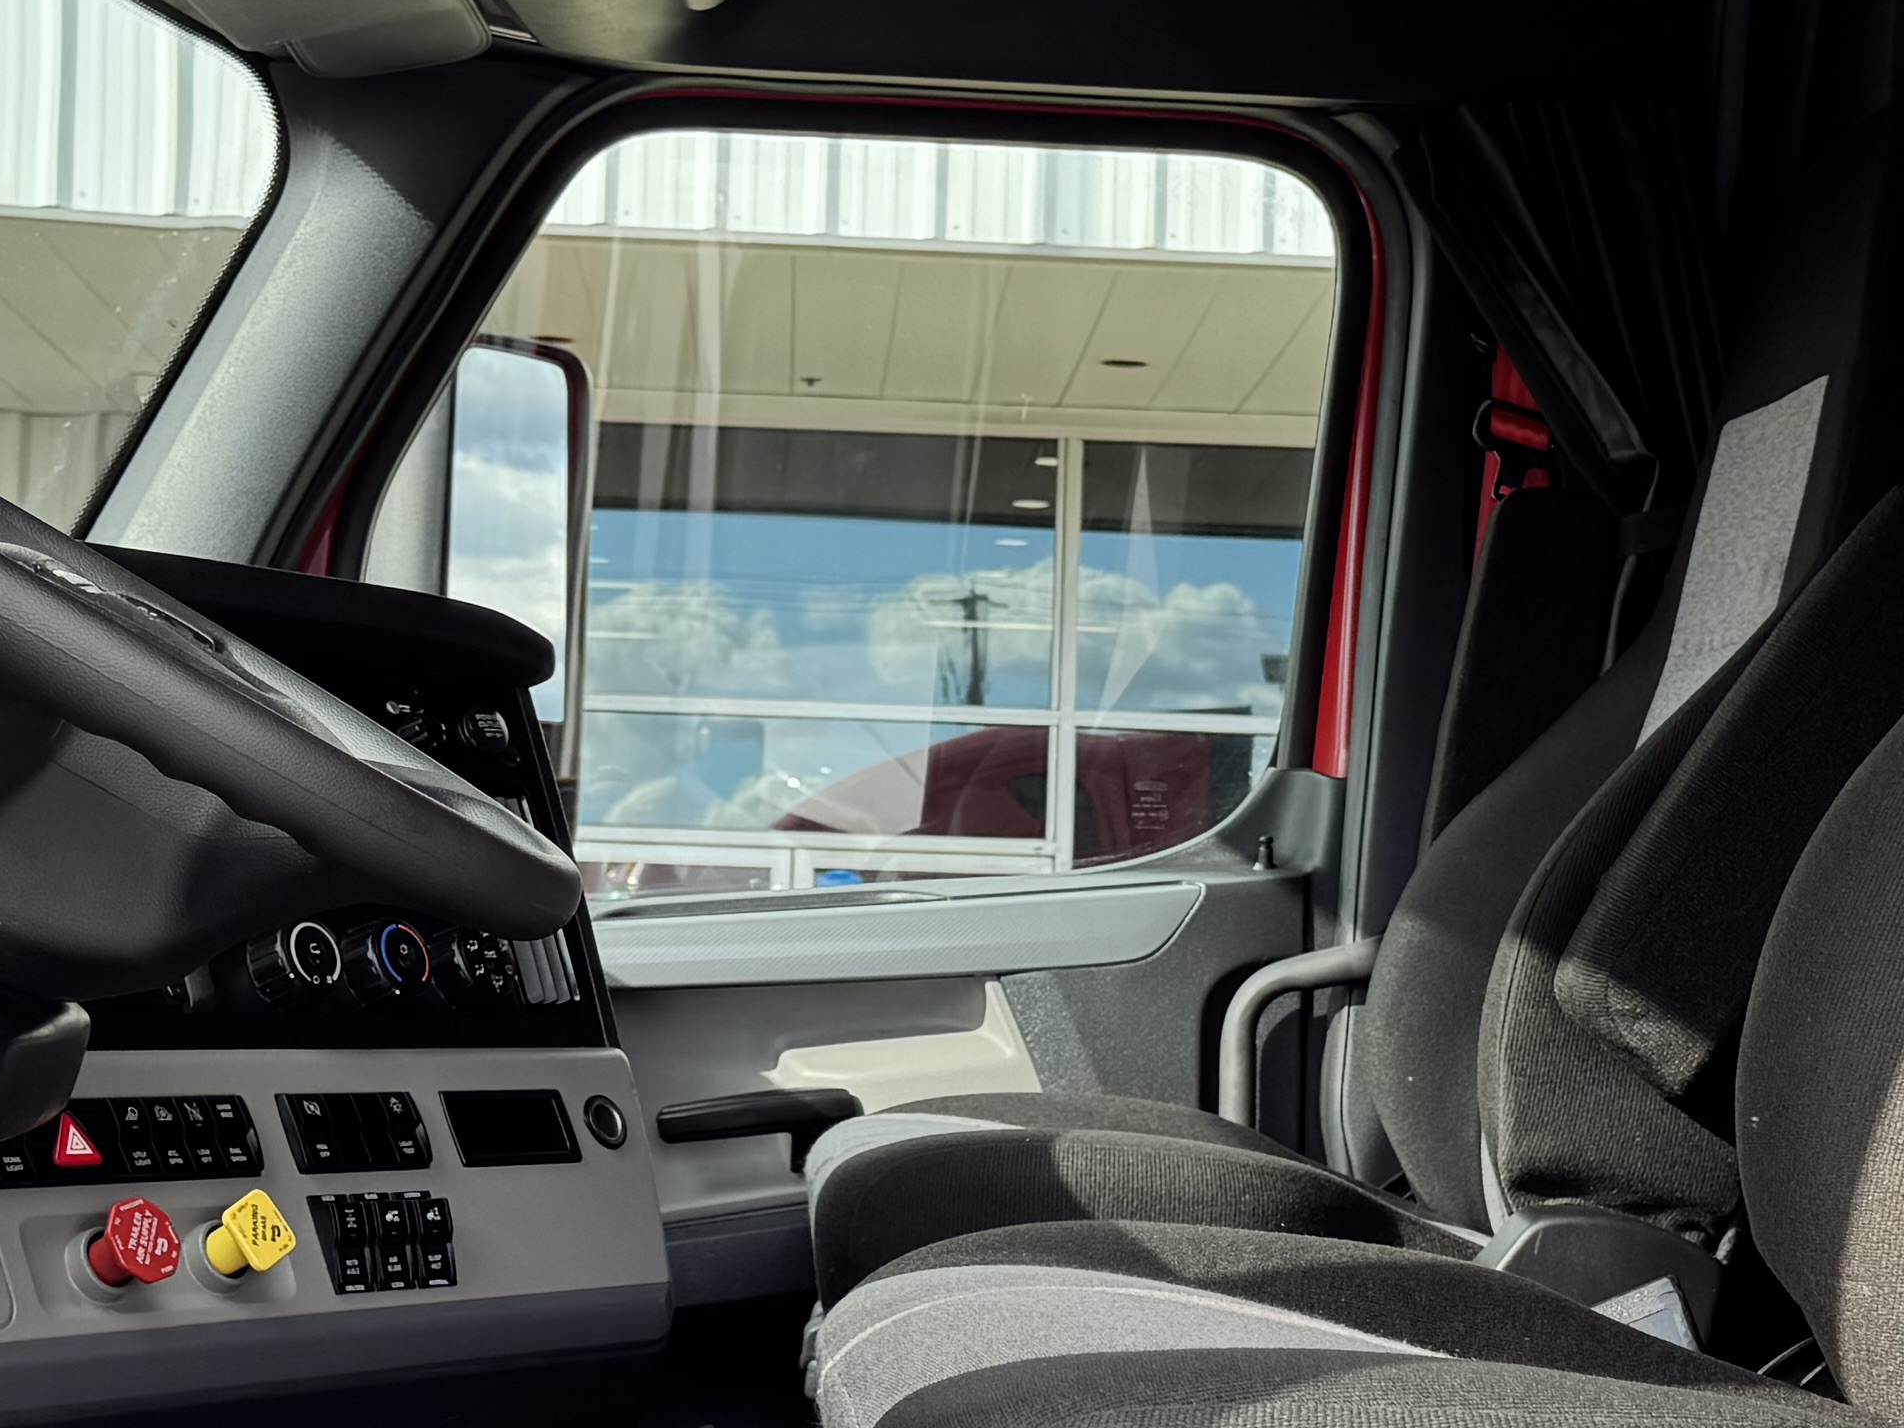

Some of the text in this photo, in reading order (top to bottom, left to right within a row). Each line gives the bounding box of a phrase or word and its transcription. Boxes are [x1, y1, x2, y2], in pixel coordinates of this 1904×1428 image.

[128, 1212, 143, 1250] TRAILER
[140, 1209, 153, 1247] SUPPLY
[251, 1204, 259, 1246] PARKING
[136, 1246, 146, 1264] AIR
